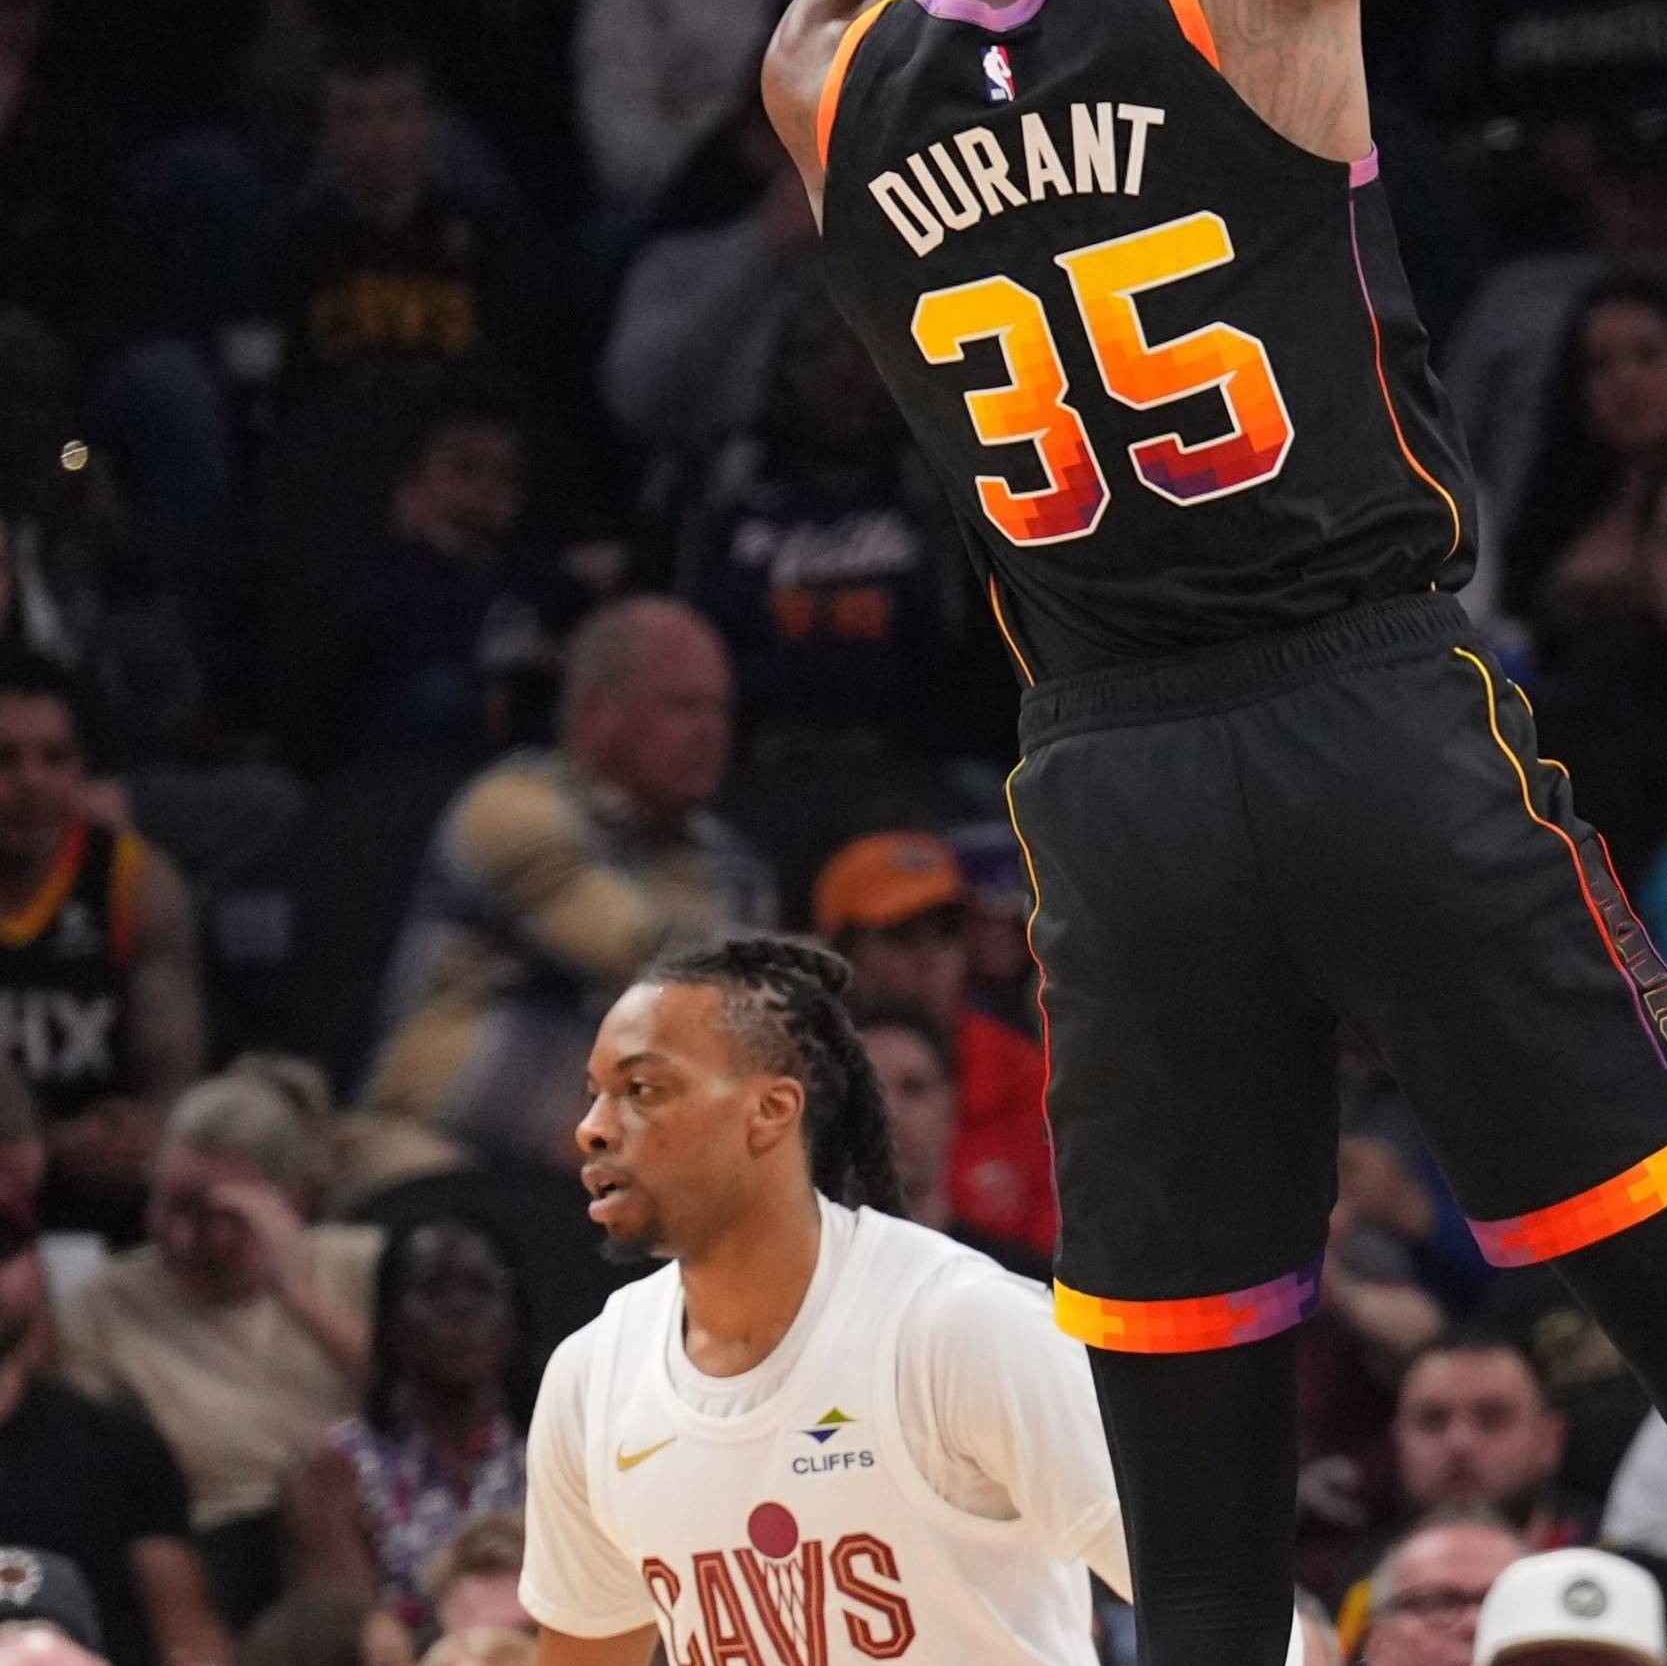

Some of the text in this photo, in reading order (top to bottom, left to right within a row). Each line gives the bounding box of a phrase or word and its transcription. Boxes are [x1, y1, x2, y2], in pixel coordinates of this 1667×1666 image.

[868, 101, 1166, 258] DURANT
[911, 209, 1296, 547] 35
[791, 1448, 876, 1476] CLIFFS
